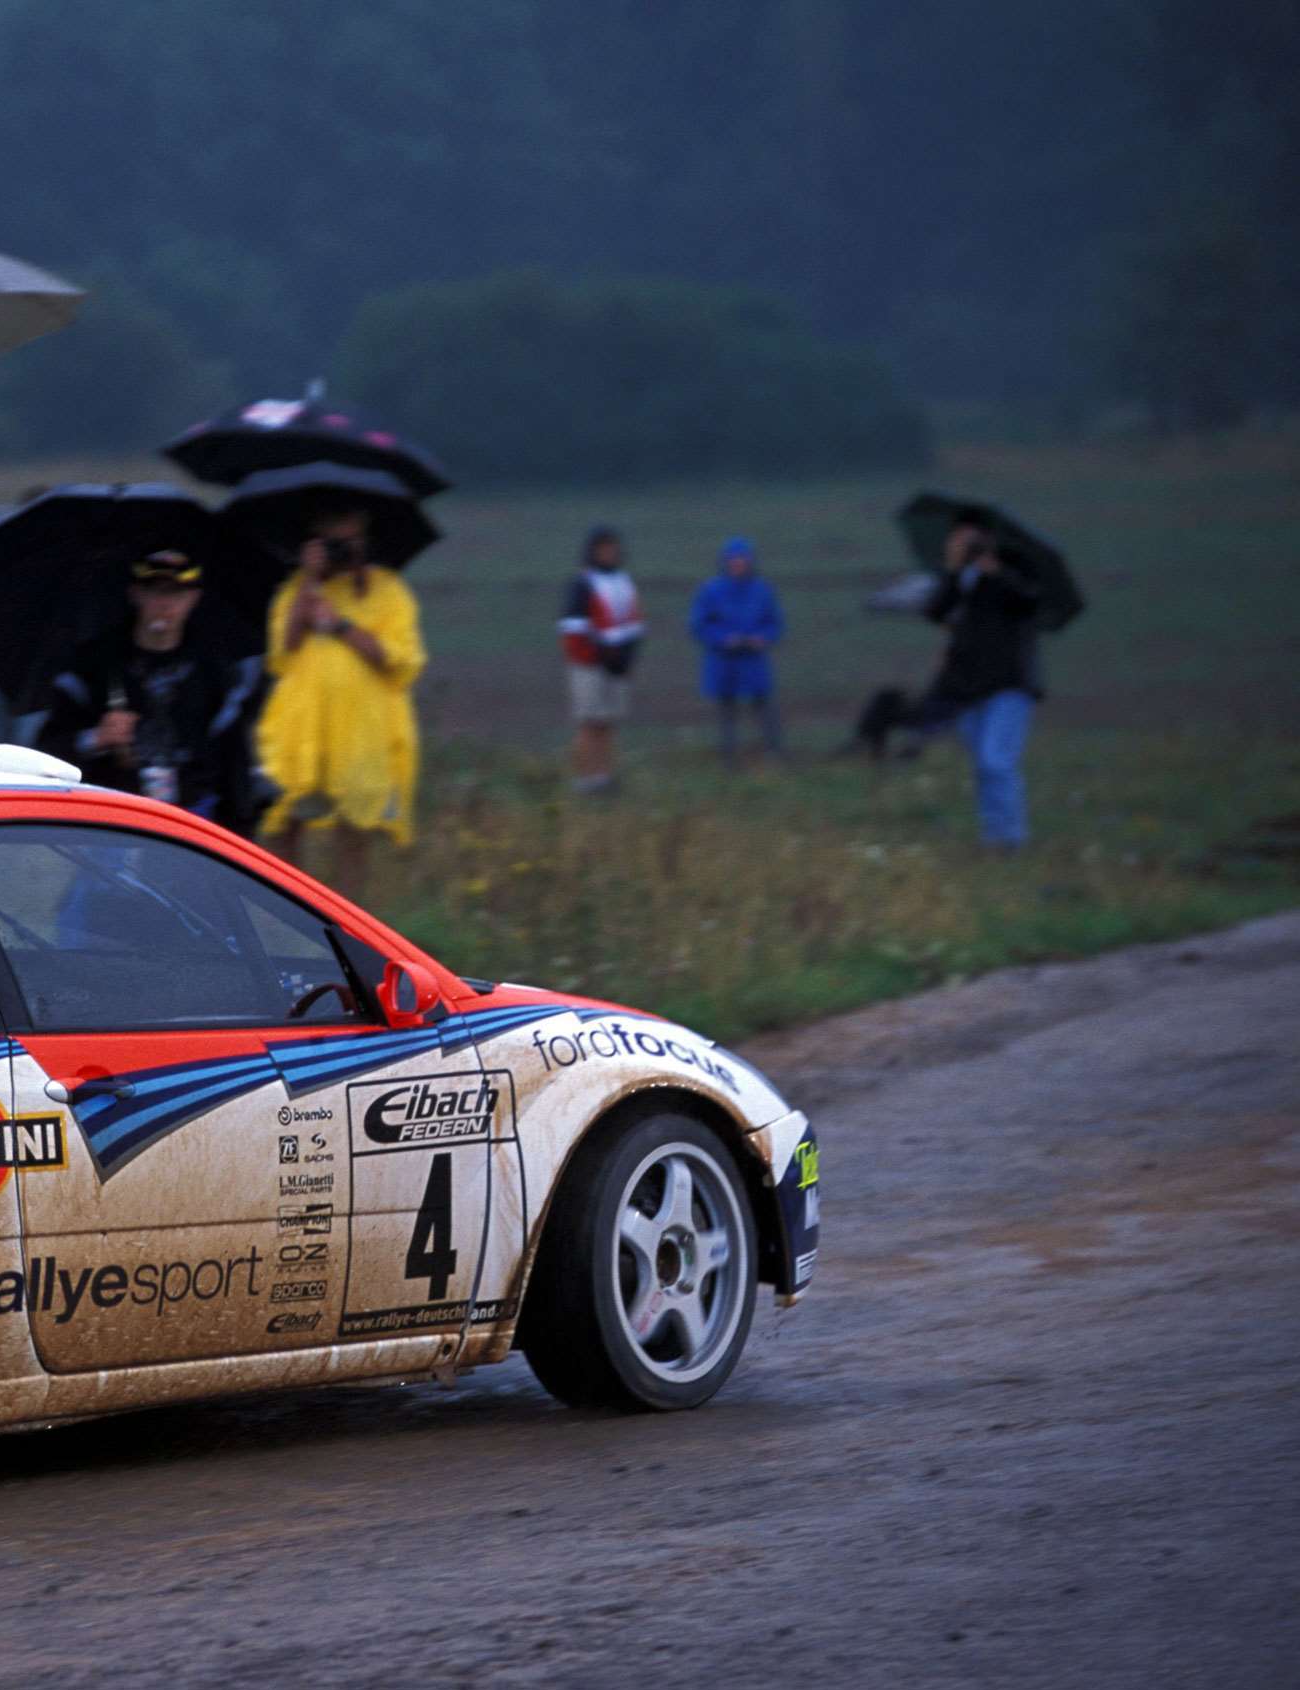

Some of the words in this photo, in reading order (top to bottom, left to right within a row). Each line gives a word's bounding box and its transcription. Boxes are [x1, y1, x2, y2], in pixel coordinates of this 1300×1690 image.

[533, 1021, 741, 1096] fordfocus
[293, 1107, 333, 1122] brembo
[363, 1079, 499, 1143] Eibach
[399, 1117, 489, 1141] FEDERN
[404, 1152, 457, 1301] 4
[279, 1243, 328, 1261] OZ
[274, 1281, 326, 1298] sparco
